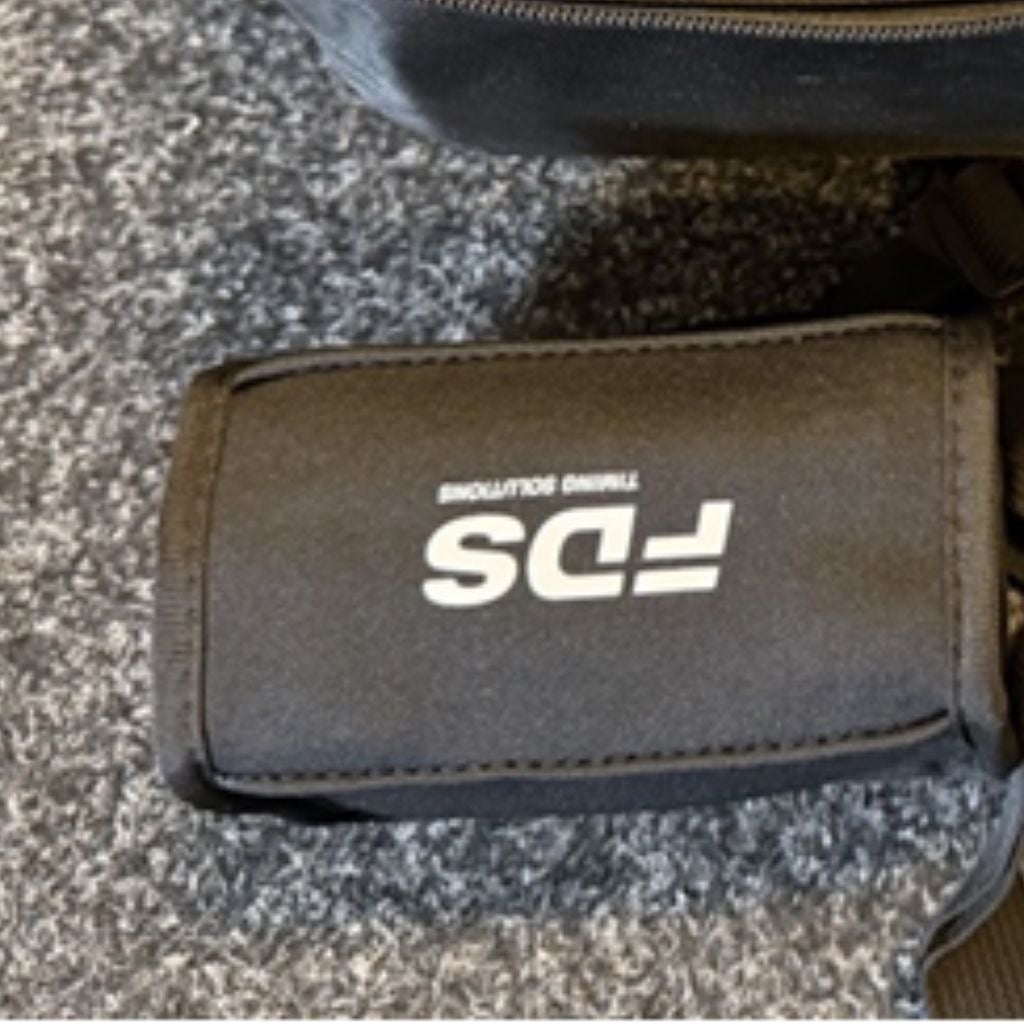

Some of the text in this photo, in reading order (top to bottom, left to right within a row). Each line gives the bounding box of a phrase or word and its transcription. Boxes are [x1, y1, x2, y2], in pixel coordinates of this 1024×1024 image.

[437, 471, 640, 504] TIMING SOLUTIONS
[422, 498, 734, 608] FDS
